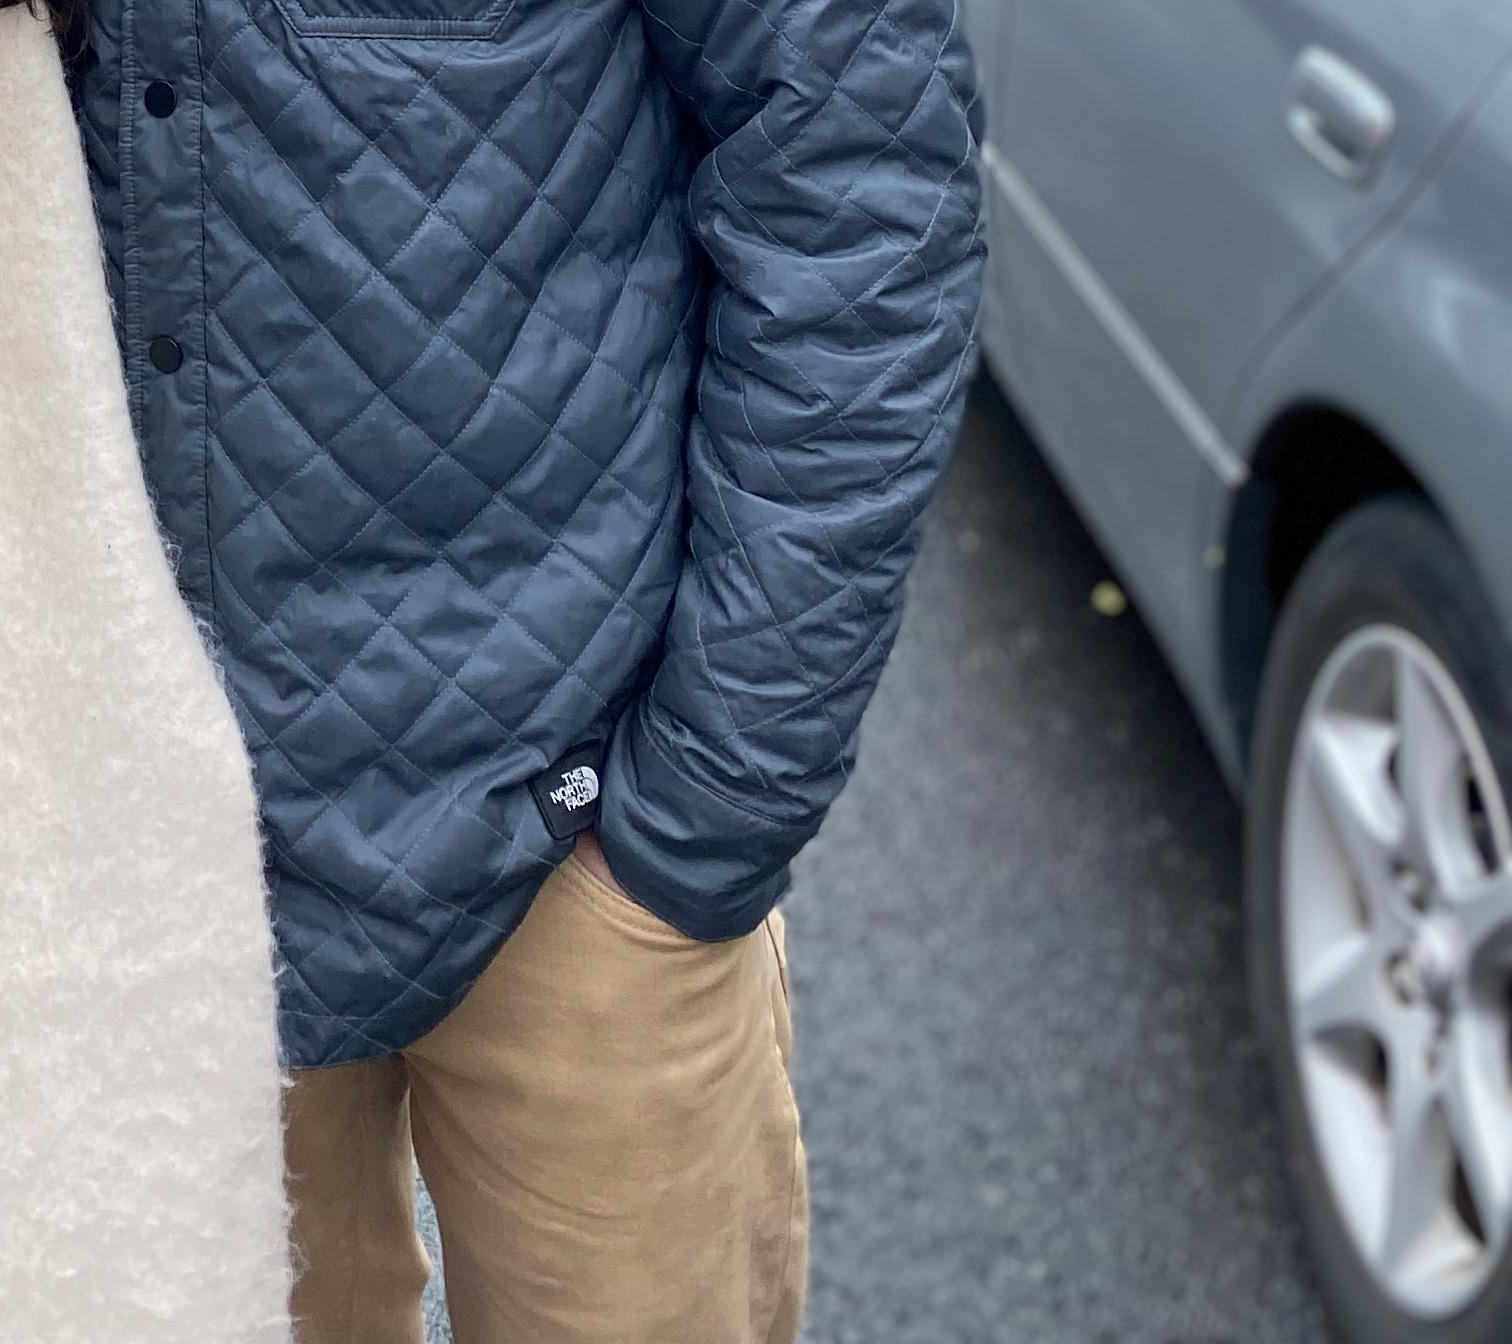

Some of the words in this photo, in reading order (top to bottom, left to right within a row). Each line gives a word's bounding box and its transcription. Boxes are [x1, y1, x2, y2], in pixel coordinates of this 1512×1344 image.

[561, 768, 584, 785] THE
[550, 780, 586, 804] NORTH
[565, 792, 589, 811] FACE
